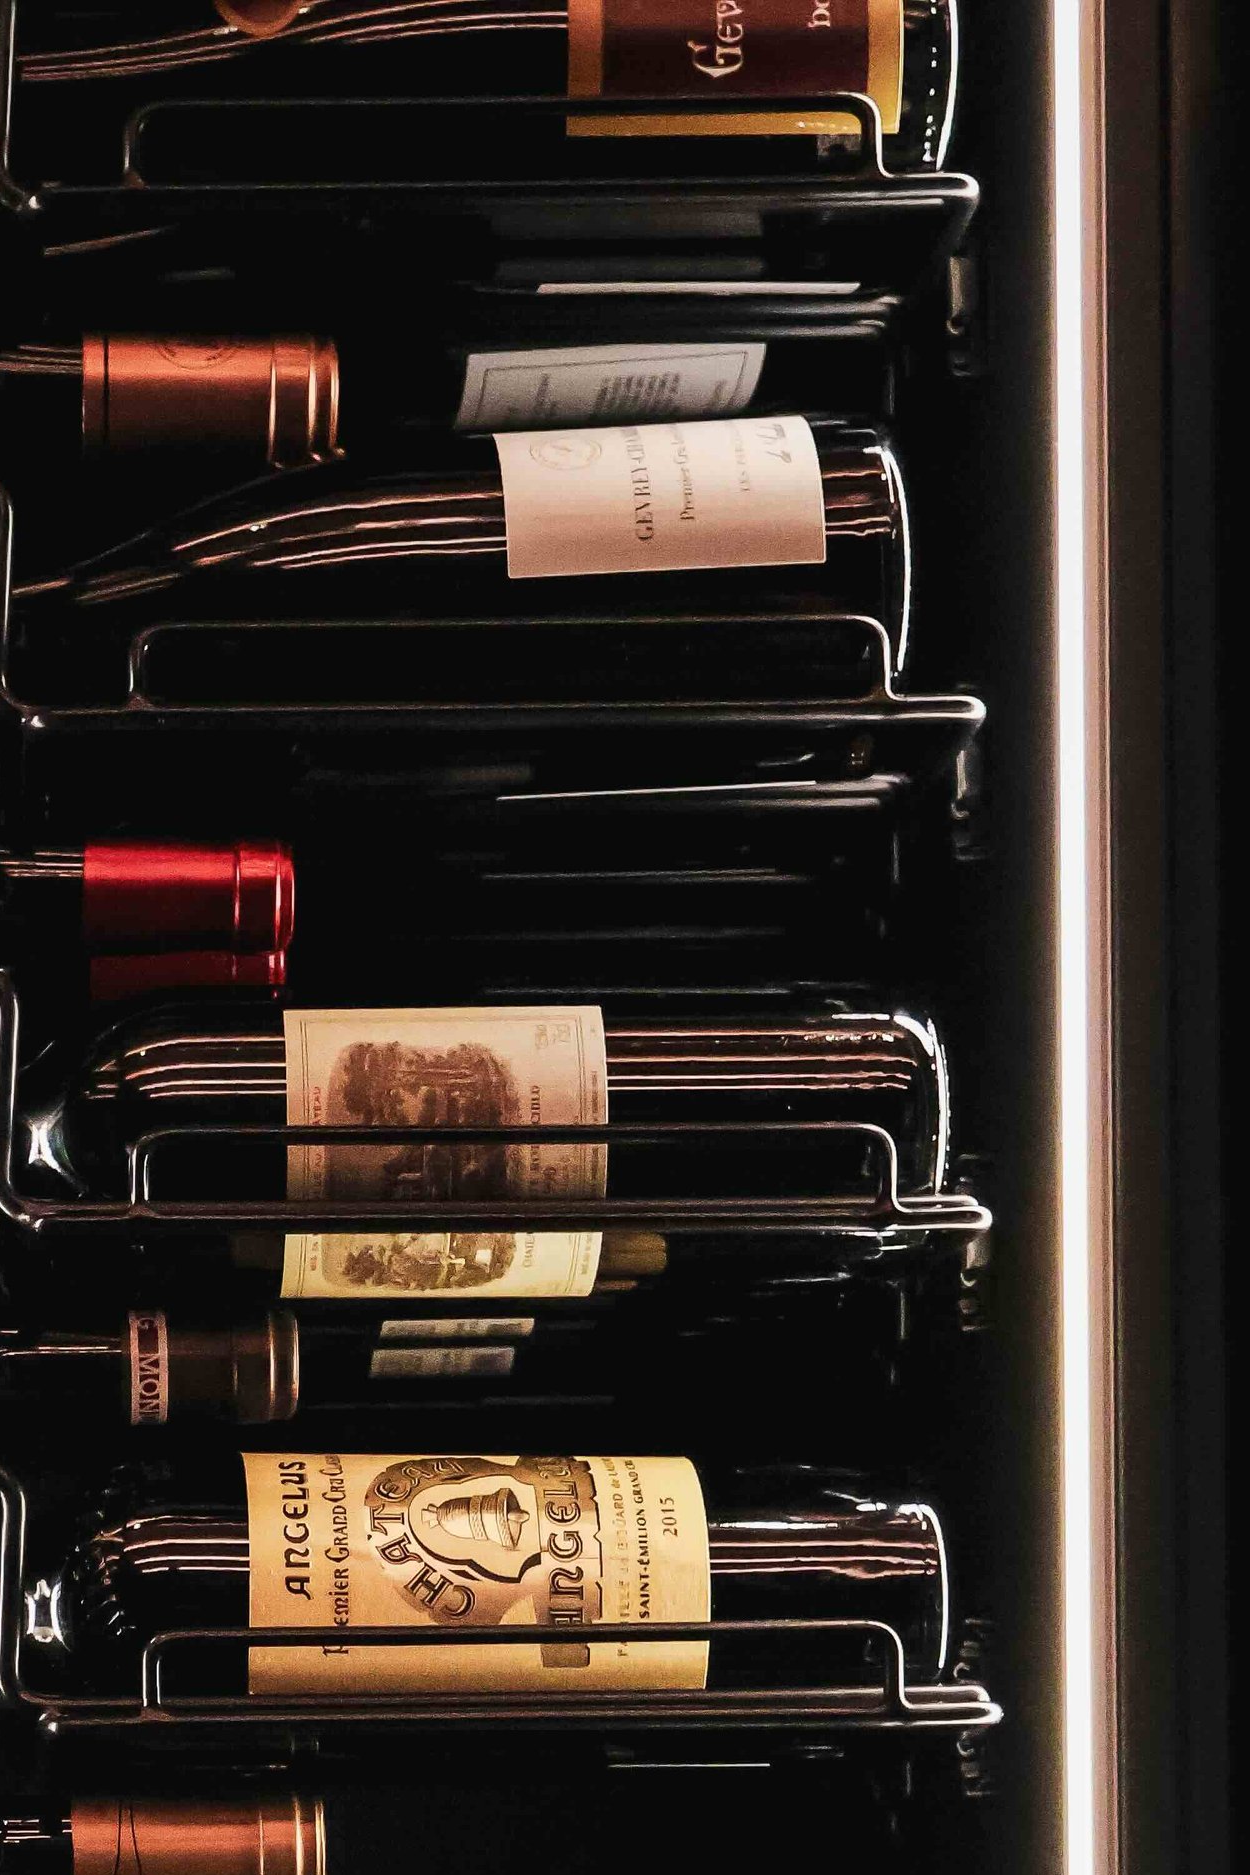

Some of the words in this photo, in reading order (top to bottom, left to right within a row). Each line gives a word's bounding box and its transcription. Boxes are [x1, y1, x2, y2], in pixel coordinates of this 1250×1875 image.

[277, 1461, 312, 1601] ANGELUS
[634, 1508, 651, 1620] SAINT-ÉMILION
[659, 1496, 679, 1537] 2015
